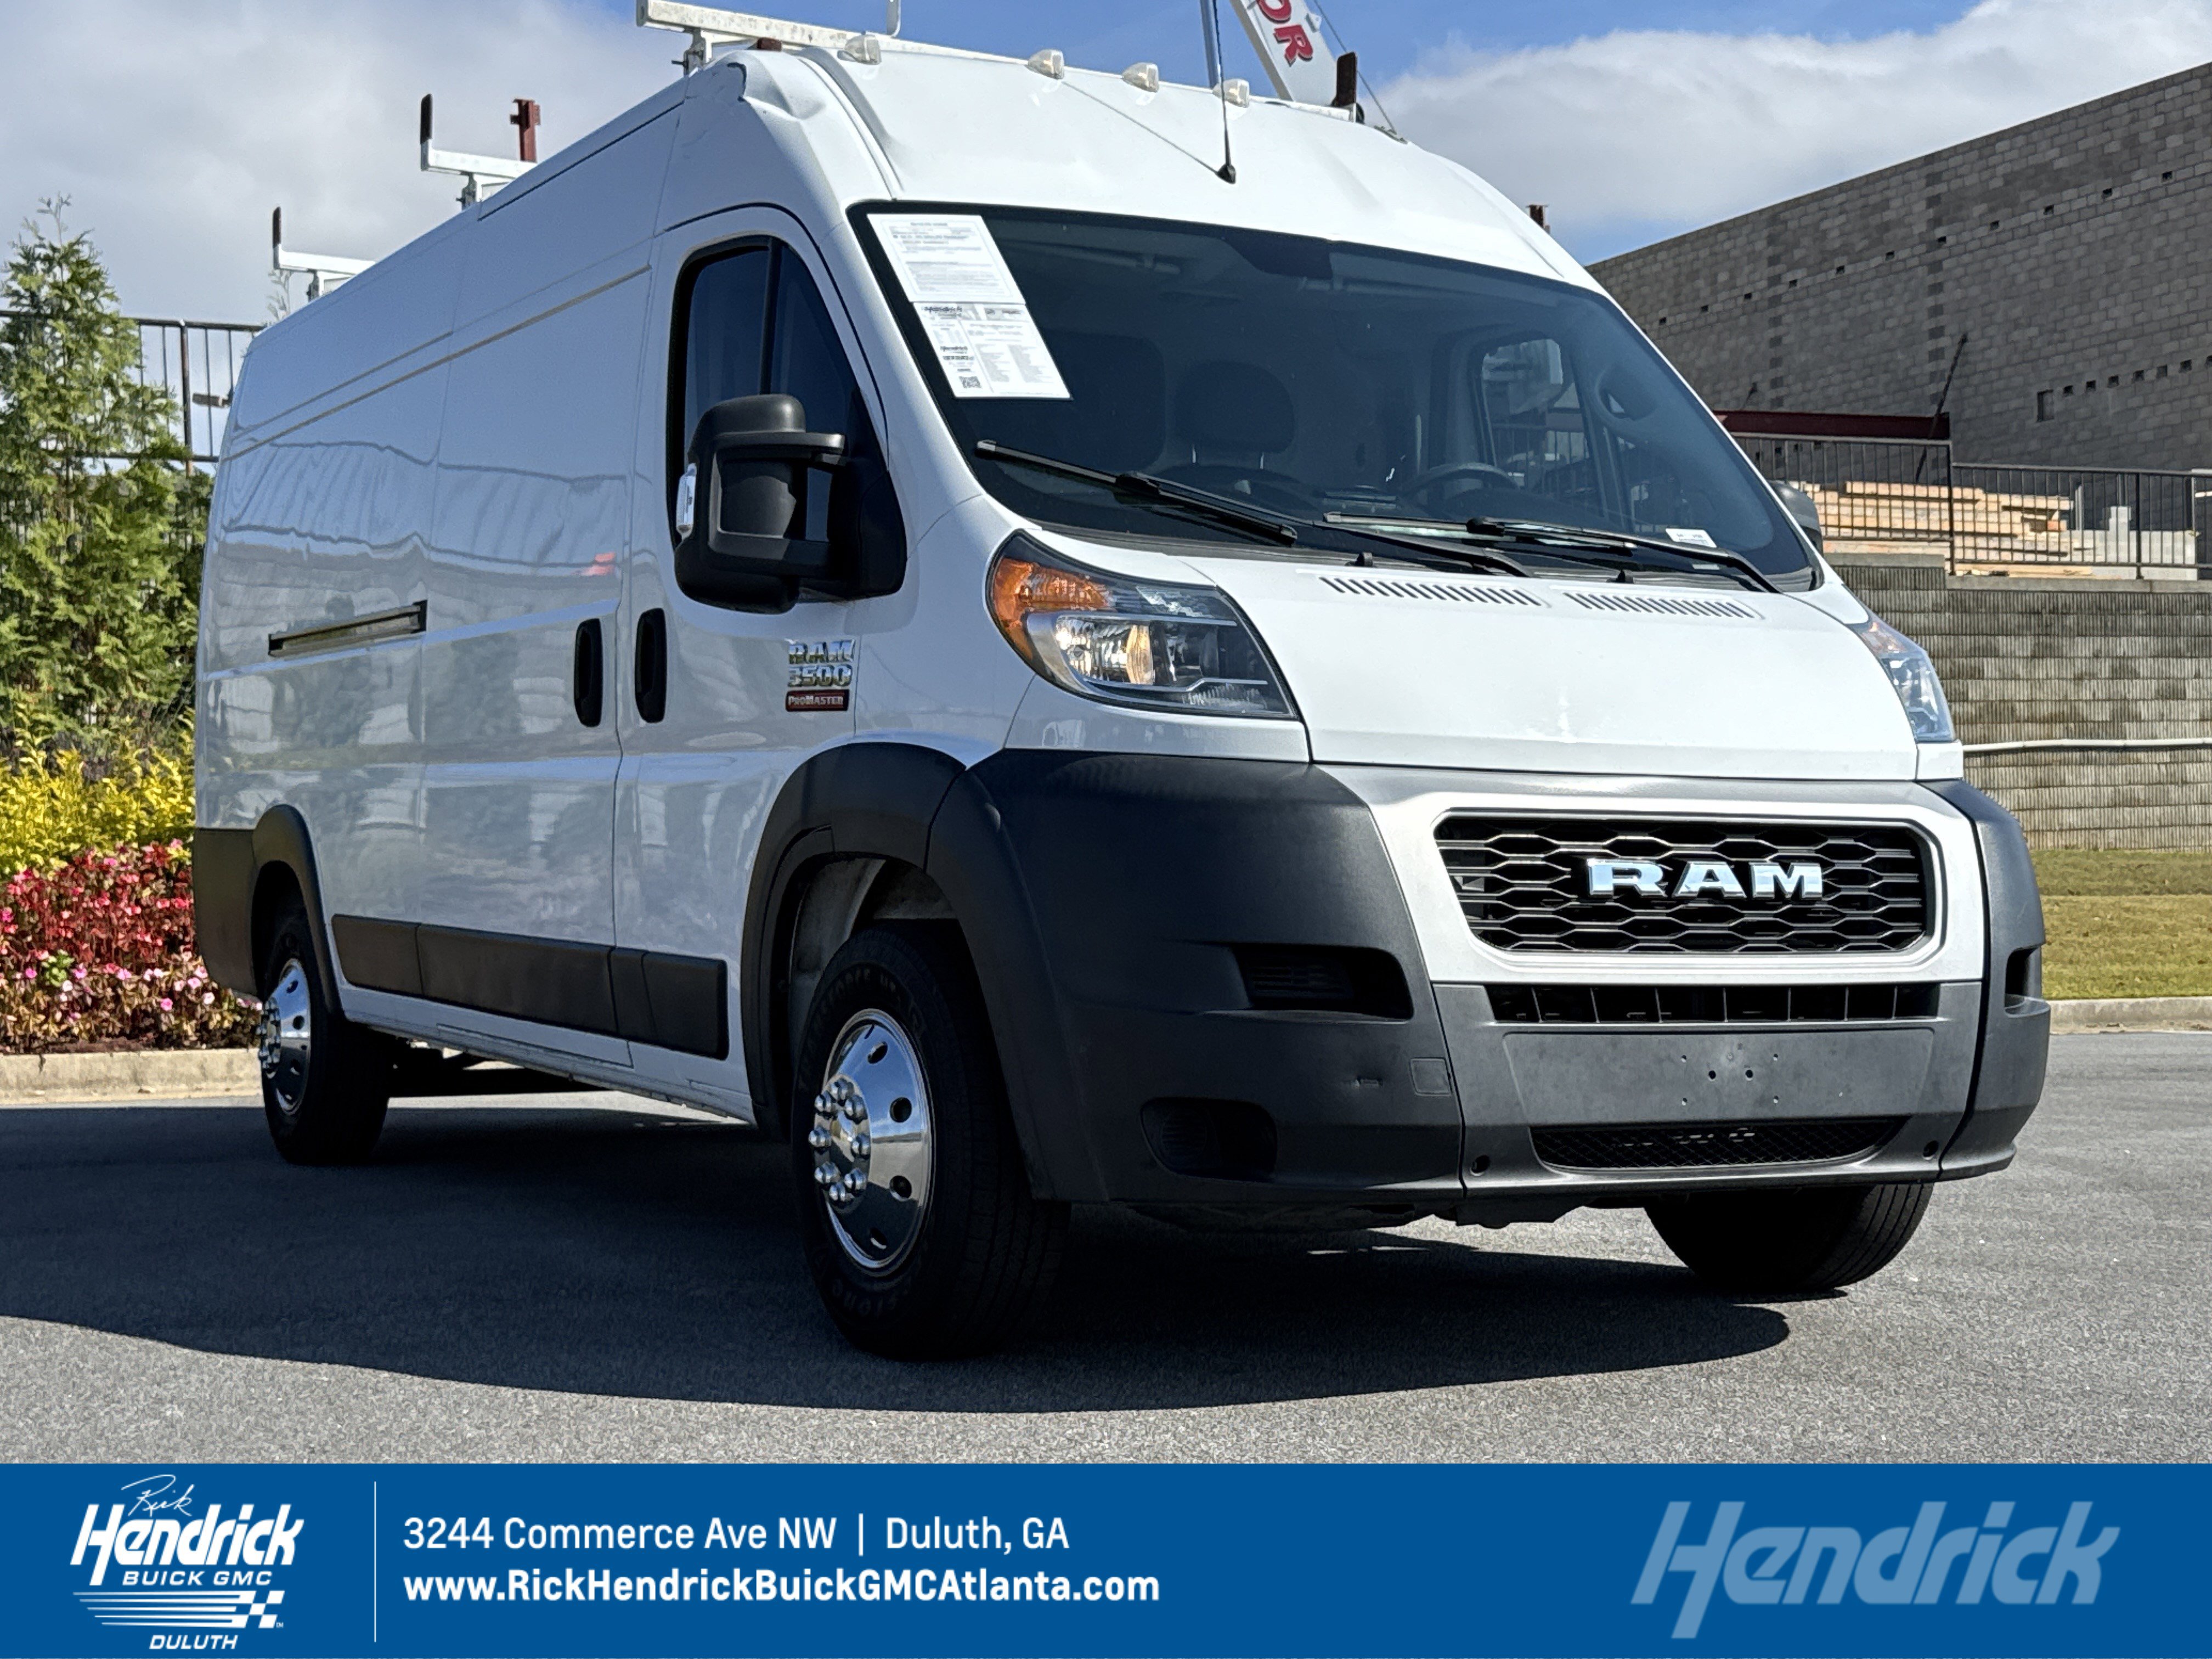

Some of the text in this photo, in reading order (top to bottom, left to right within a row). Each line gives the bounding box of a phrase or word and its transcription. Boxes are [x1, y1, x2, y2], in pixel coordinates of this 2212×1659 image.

[788, 640, 855, 664] RAM
[788, 663, 852, 687] 3500
[1587, 858, 1823, 900] RAM
